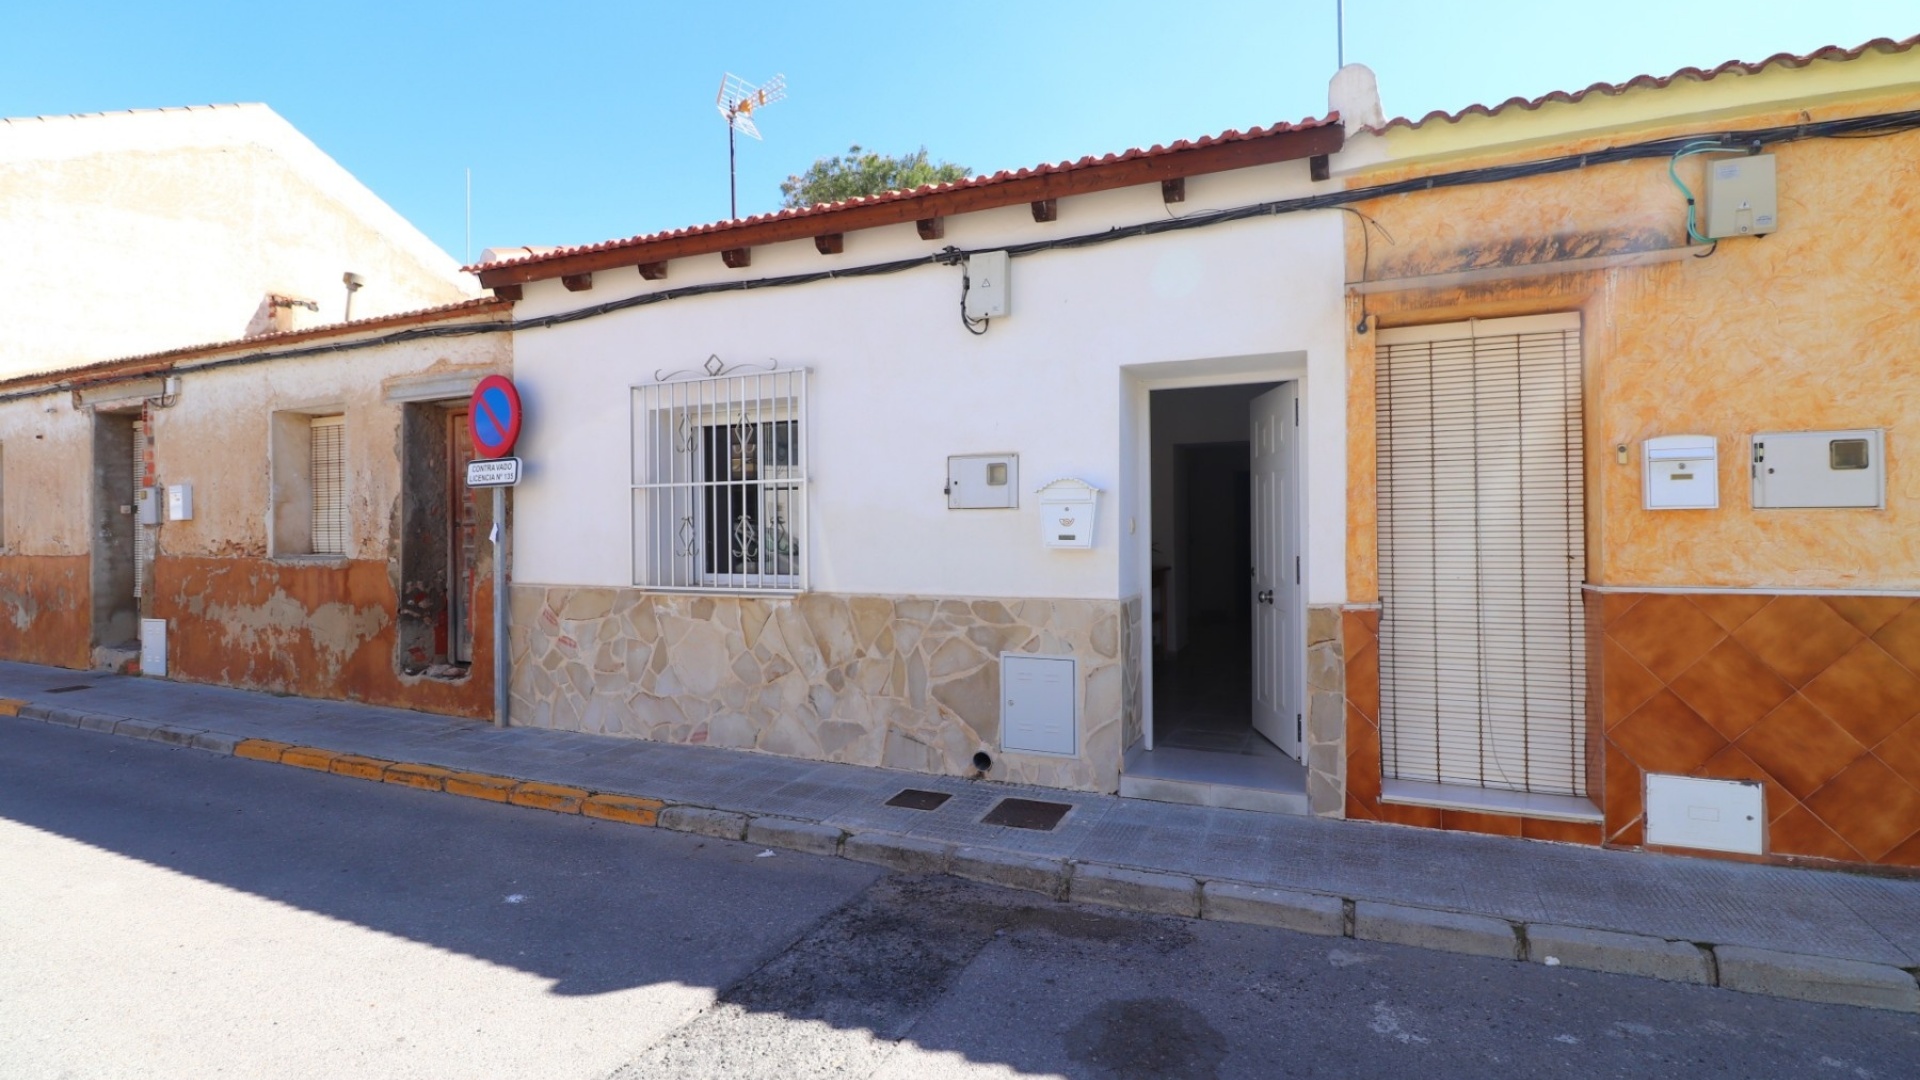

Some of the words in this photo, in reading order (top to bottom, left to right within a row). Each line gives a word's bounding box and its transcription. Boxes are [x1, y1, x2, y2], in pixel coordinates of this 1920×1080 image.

[472, 464, 496, 473] CONTRA
[496, 463, 512, 471] VADO
[469, 474, 496, 482] LICENCIA
